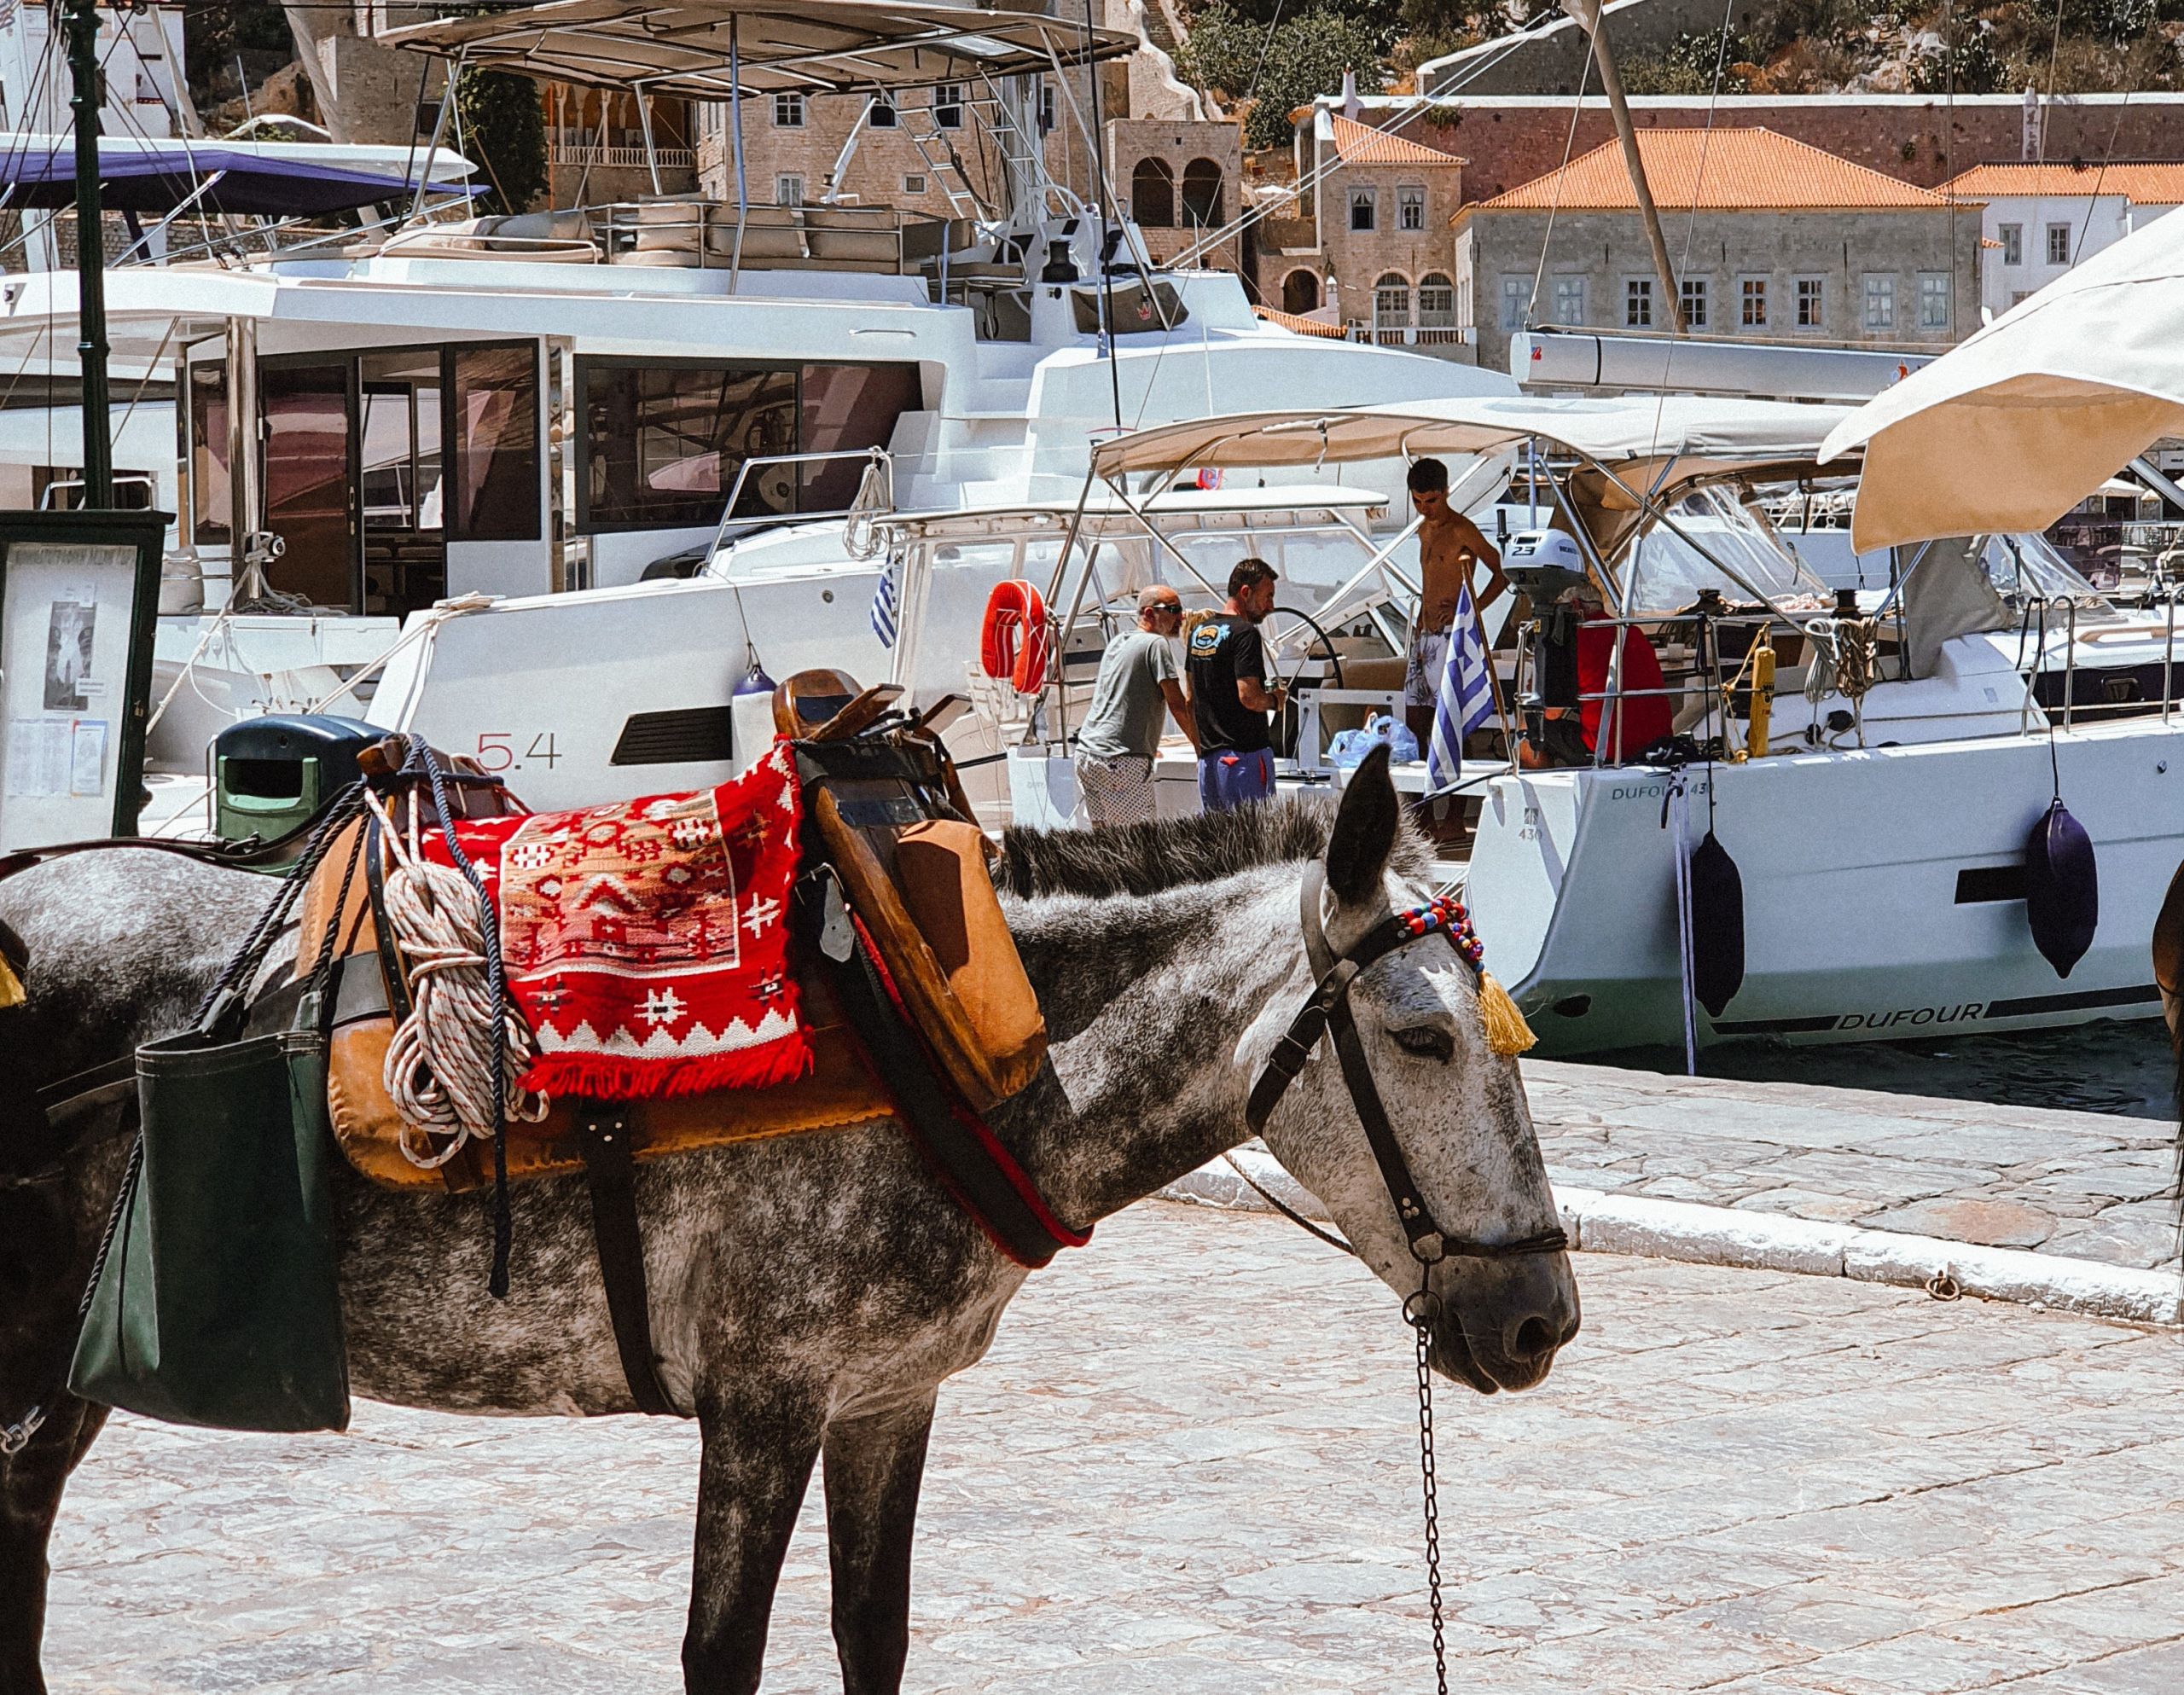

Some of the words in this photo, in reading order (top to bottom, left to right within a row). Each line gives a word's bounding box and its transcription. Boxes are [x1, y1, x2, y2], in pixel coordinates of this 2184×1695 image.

[1512, 546, 1536, 556] 23
[477, 733, 562, 771] 5.4
[1612, 785, 1672, 800] DUFO
[1519, 827, 1542, 840] 430
[1838, 1003, 1984, 1030] DUFOUR
